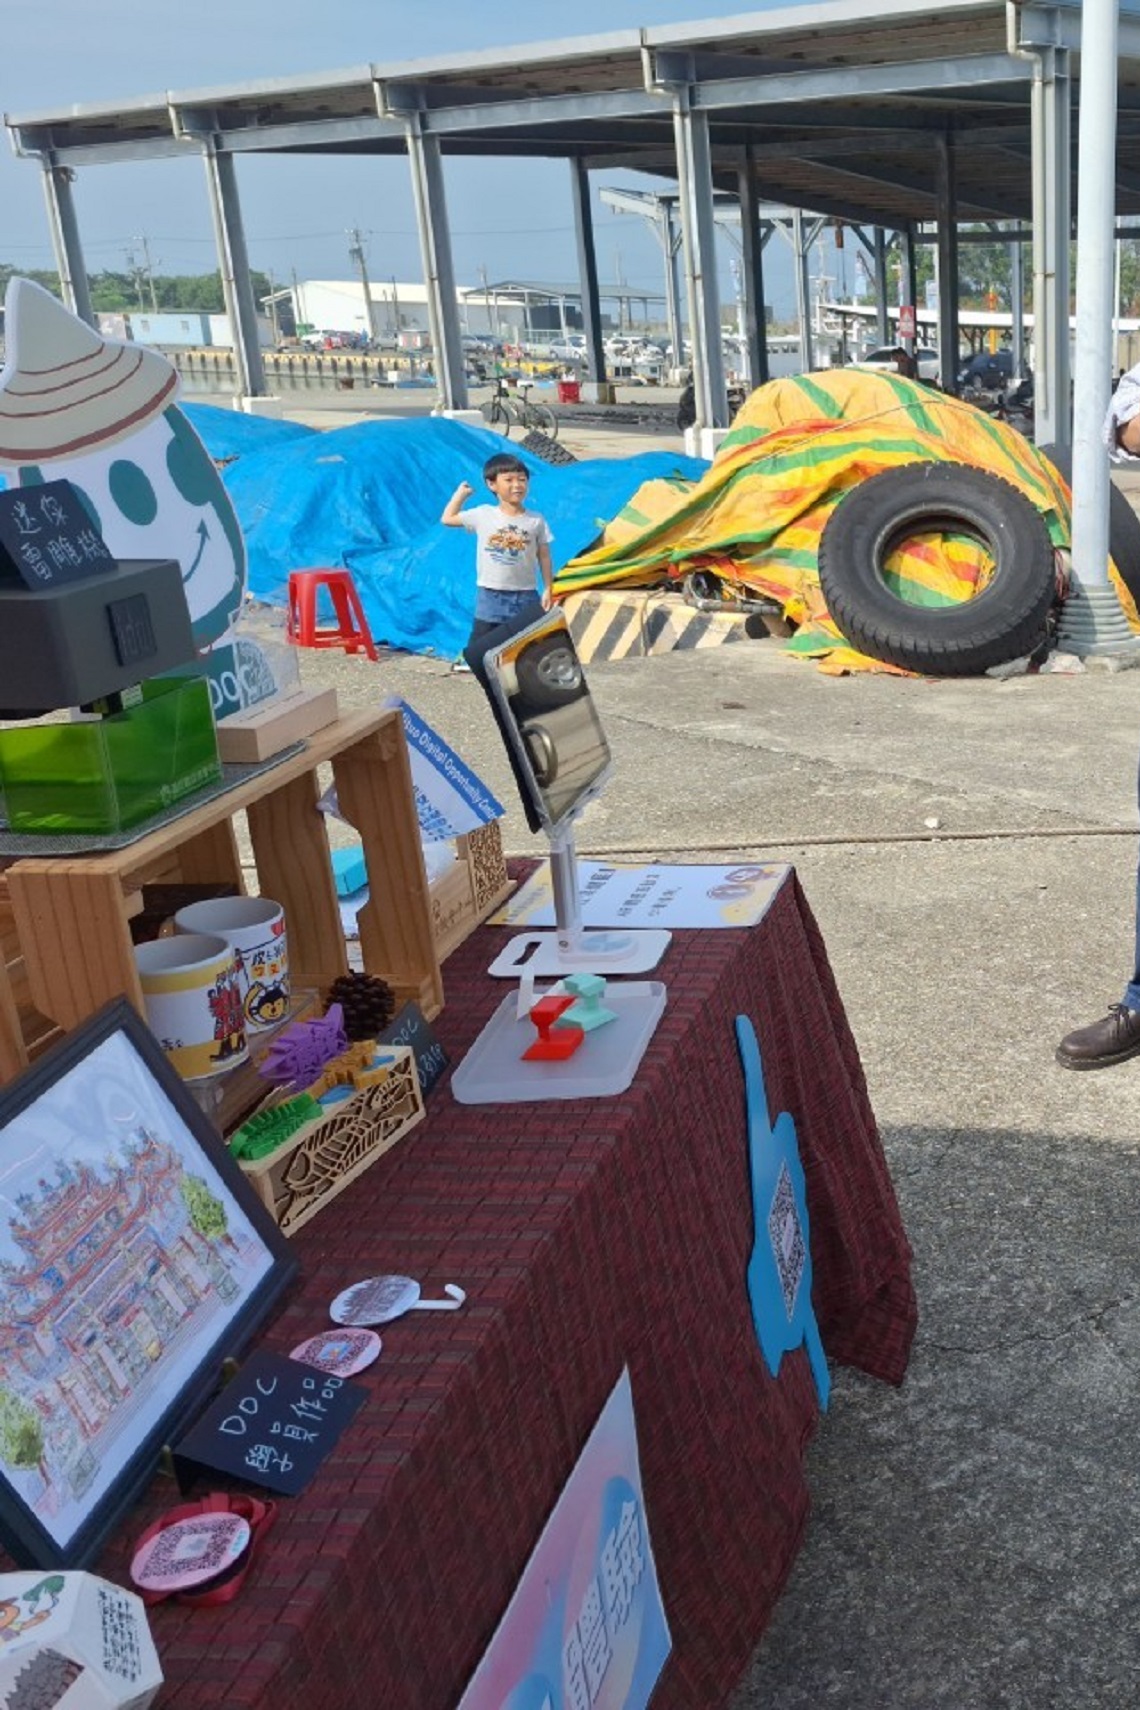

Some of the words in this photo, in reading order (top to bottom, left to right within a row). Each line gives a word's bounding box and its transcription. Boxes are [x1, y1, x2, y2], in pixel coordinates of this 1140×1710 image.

[419, 732, 448, 764] Digital
[444, 759, 482, 804] Opportunity
[219, 1376, 278, 1435] DOC
[245, 1378, 343, 1472] 學員作品
